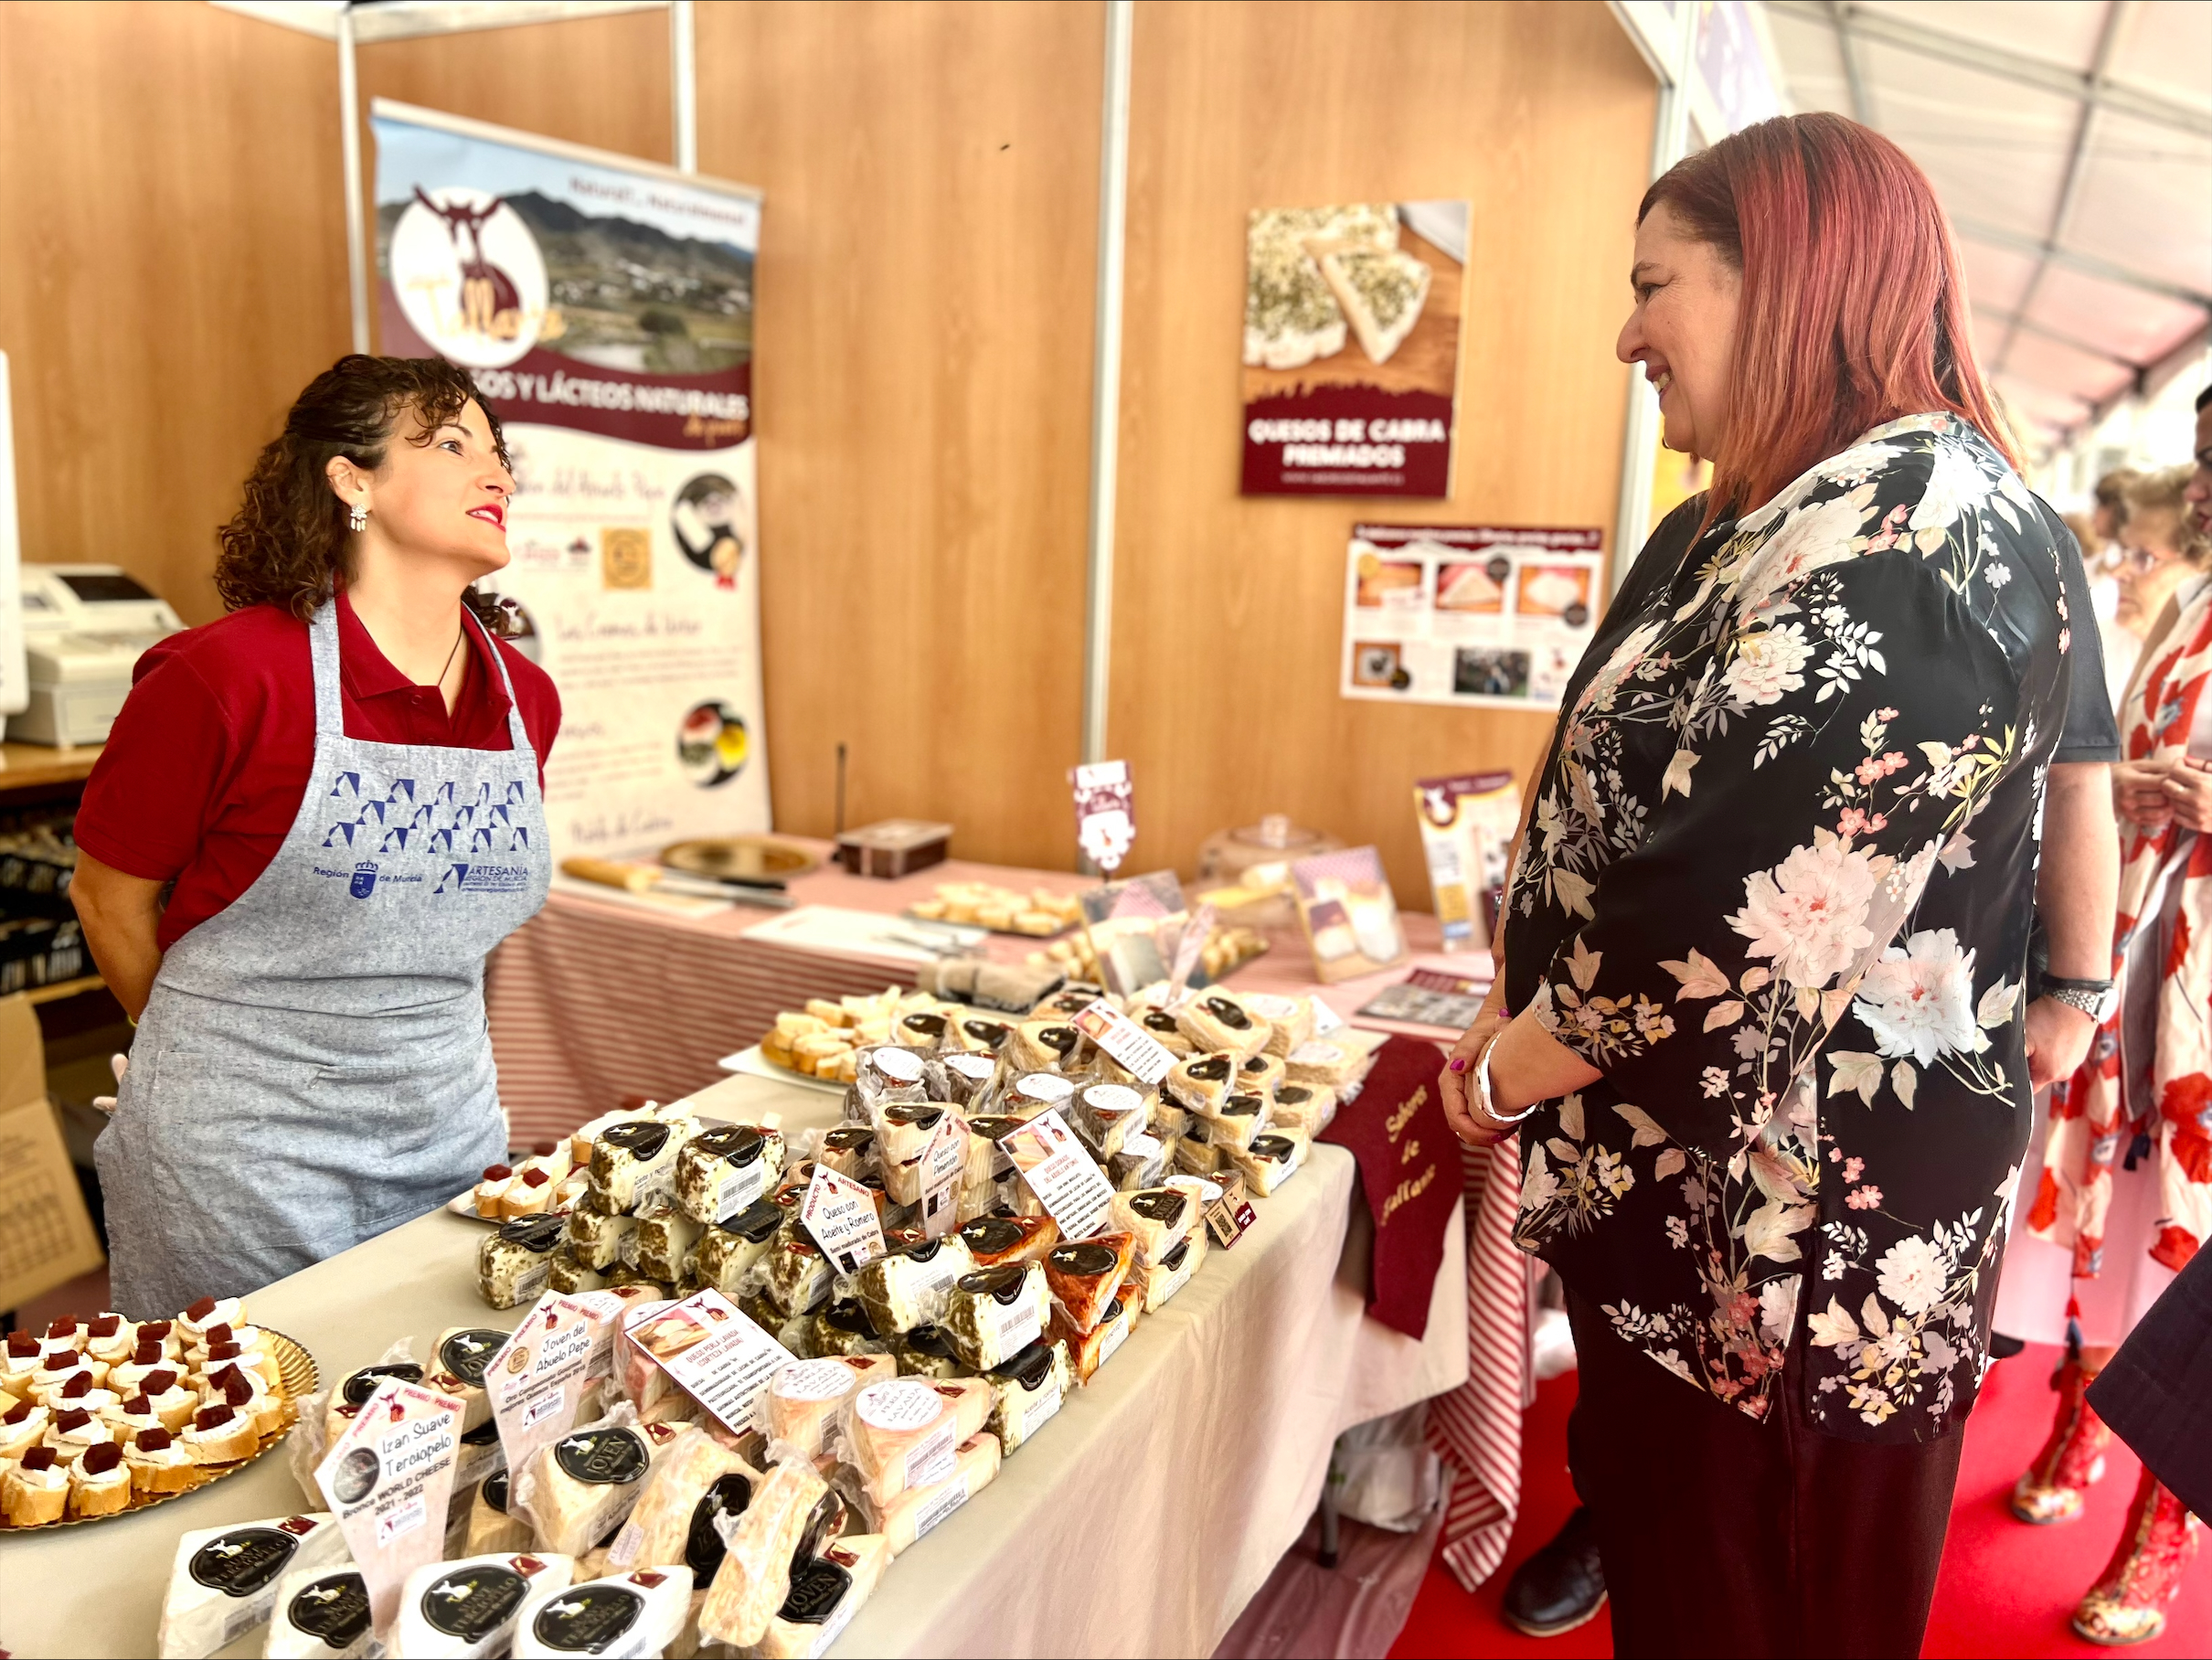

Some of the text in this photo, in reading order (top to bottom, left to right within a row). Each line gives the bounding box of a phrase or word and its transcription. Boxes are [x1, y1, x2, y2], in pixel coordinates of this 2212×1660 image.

[1249, 419, 1446, 444] QUESOS DE CABRA
[313, 867, 349, 878] Región
[393, 874, 422, 883] Murcia
[934, 1146, 950, 1162] Queso
[805, 1184, 821, 1221] PRODUCTO
[838, 1177, 870, 1197] ARTESANO
[823, 1200, 858, 1220] Queso con
[822, 1213, 875, 1241] Aceite y Romero
[558, 1299, 578, 1311] PREMIO
[580, 1307, 600, 1320] PREMIO
[487, 1314, 537, 1377] PREMIO PREMIO
[543, 1321, 586, 1353] Joven del
[686, 1329, 740, 1363] QUESO PERLA LAVADA
[536, 1350, 567, 1373] Abuelo
[569, 1339, 590, 1357] Pepe
[403, 1387, 462, 1412] PREMIO PREMIO
[352, 1402, 380, 1438] PREMIO
[382, 1413, 451, 1455] Izan Suave
[385, 1434, 452, 1477] Terciopelo
[586, 1435, 627, 1475] JOVEN
[342, 1498, 376, 1519] Bronce
[377, 1477, 413, 1502] WORLD
[415, 1457, 452, 1482] CHEESE
[375, 1501, 396, 1516] 2021
[403, 1484, 424, 1500] 2022
[792, 1574, 836, 1612] JOVEN
